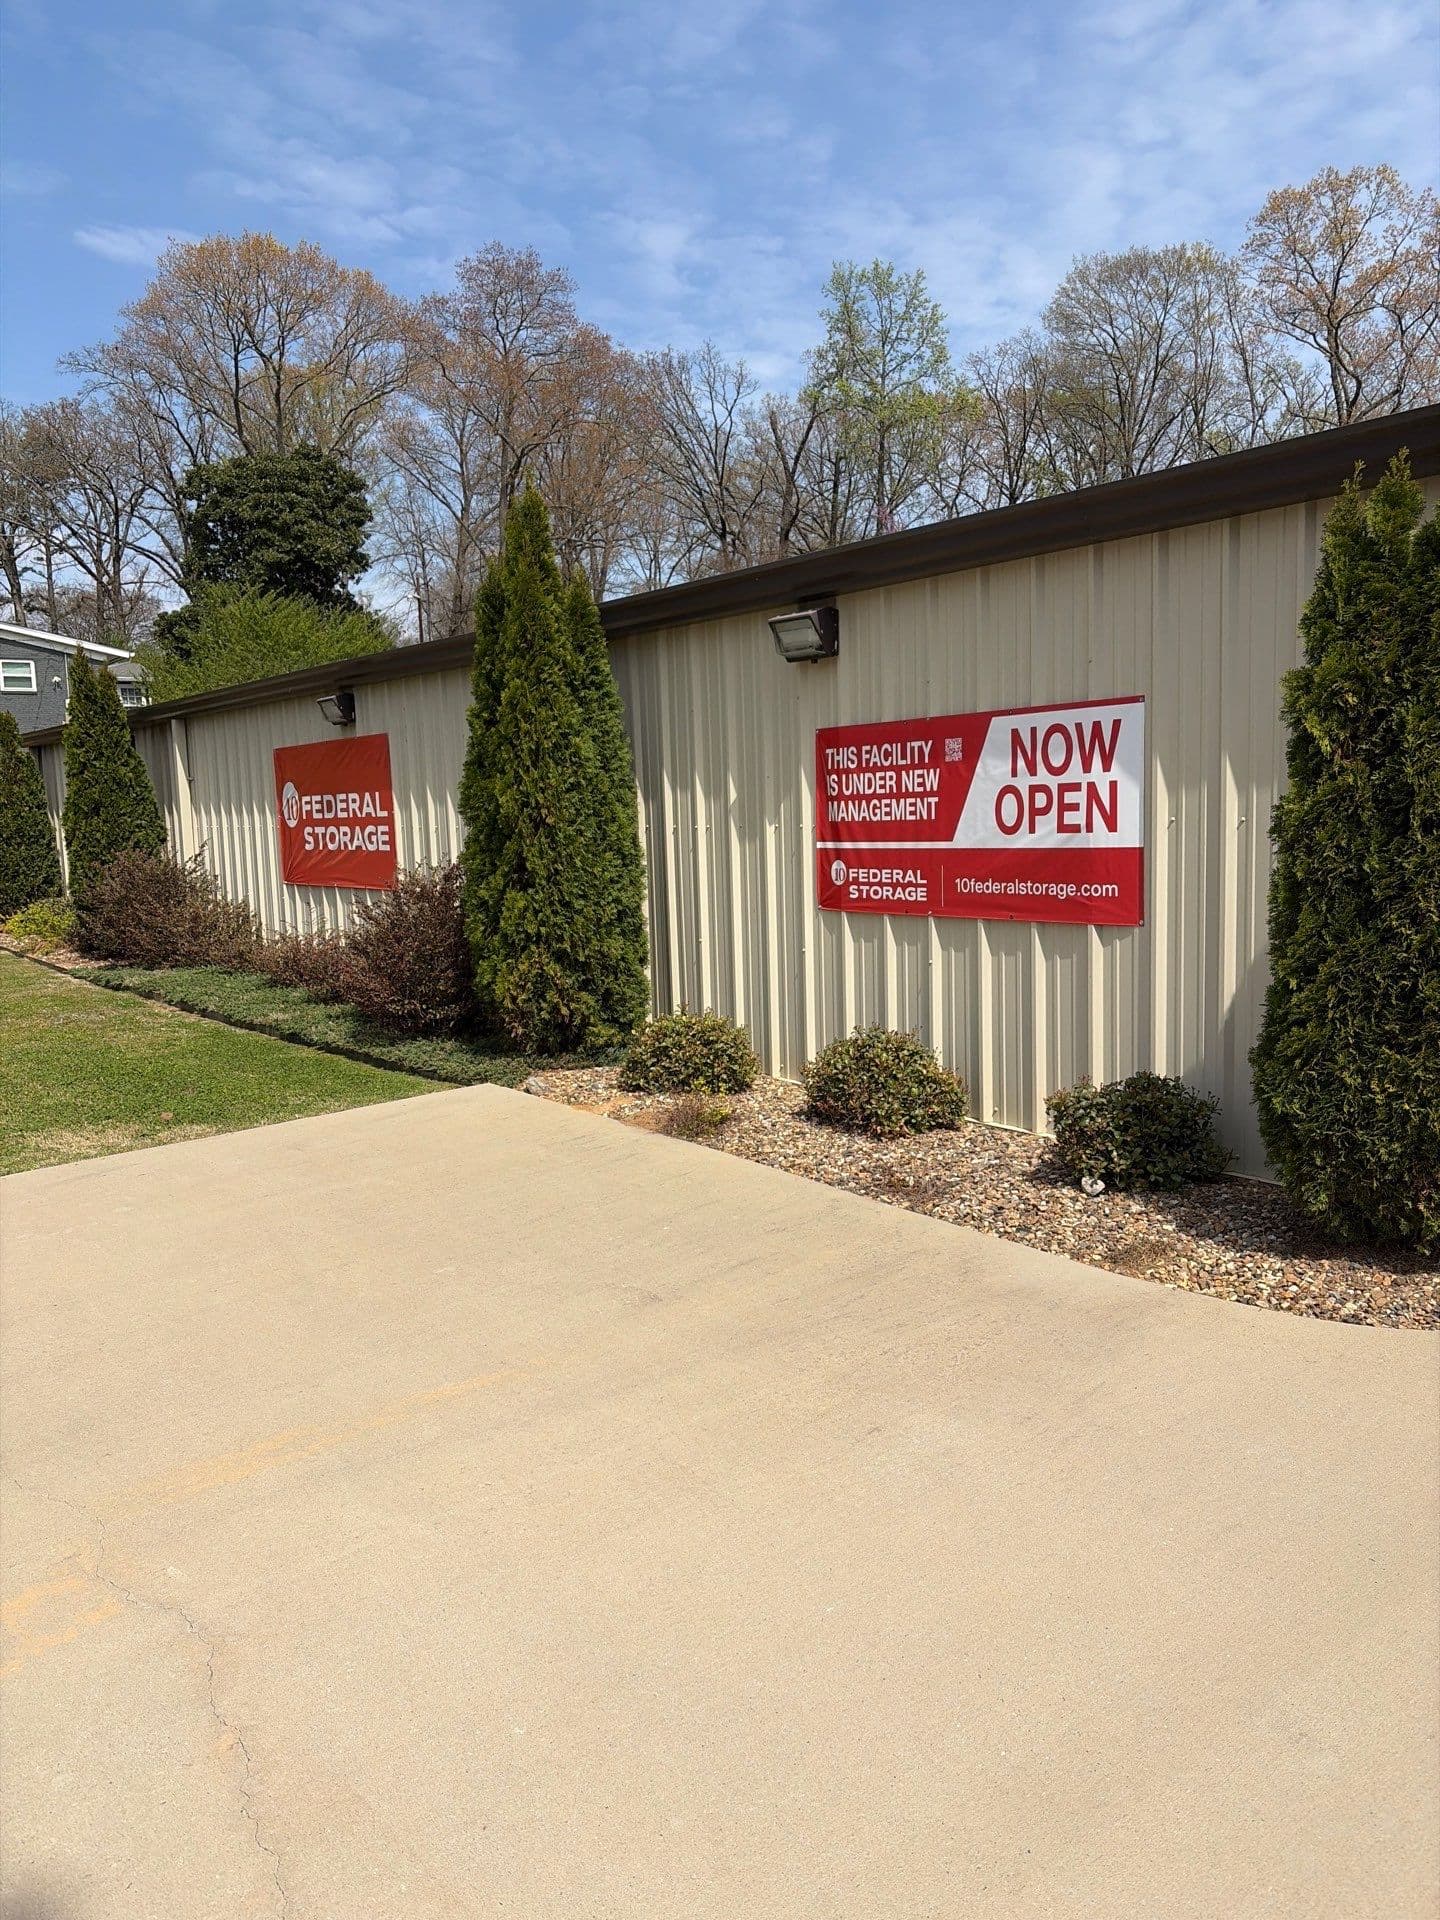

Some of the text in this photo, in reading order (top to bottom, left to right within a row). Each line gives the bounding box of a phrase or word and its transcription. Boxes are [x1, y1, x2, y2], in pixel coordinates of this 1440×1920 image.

[826, 740, 933, 769] THIS FACILITY
[1011, 719, 1122, 777] NOW
[827, 768, 940, 796] IS UNDER NEW
[283, 791, 388, 820] 10 FEDERAL
[828, 797, 939, 822] MANAGEMENT
[995, 780, 1118, 835] OPEN
[304, 825, 390, 851] STORAGE
[833, 867, 927, 884] 10 FEDERAL
[955, 878, 1119, 899] 10federalstorage.com
[849, 885, 927, 901] STORAGE
